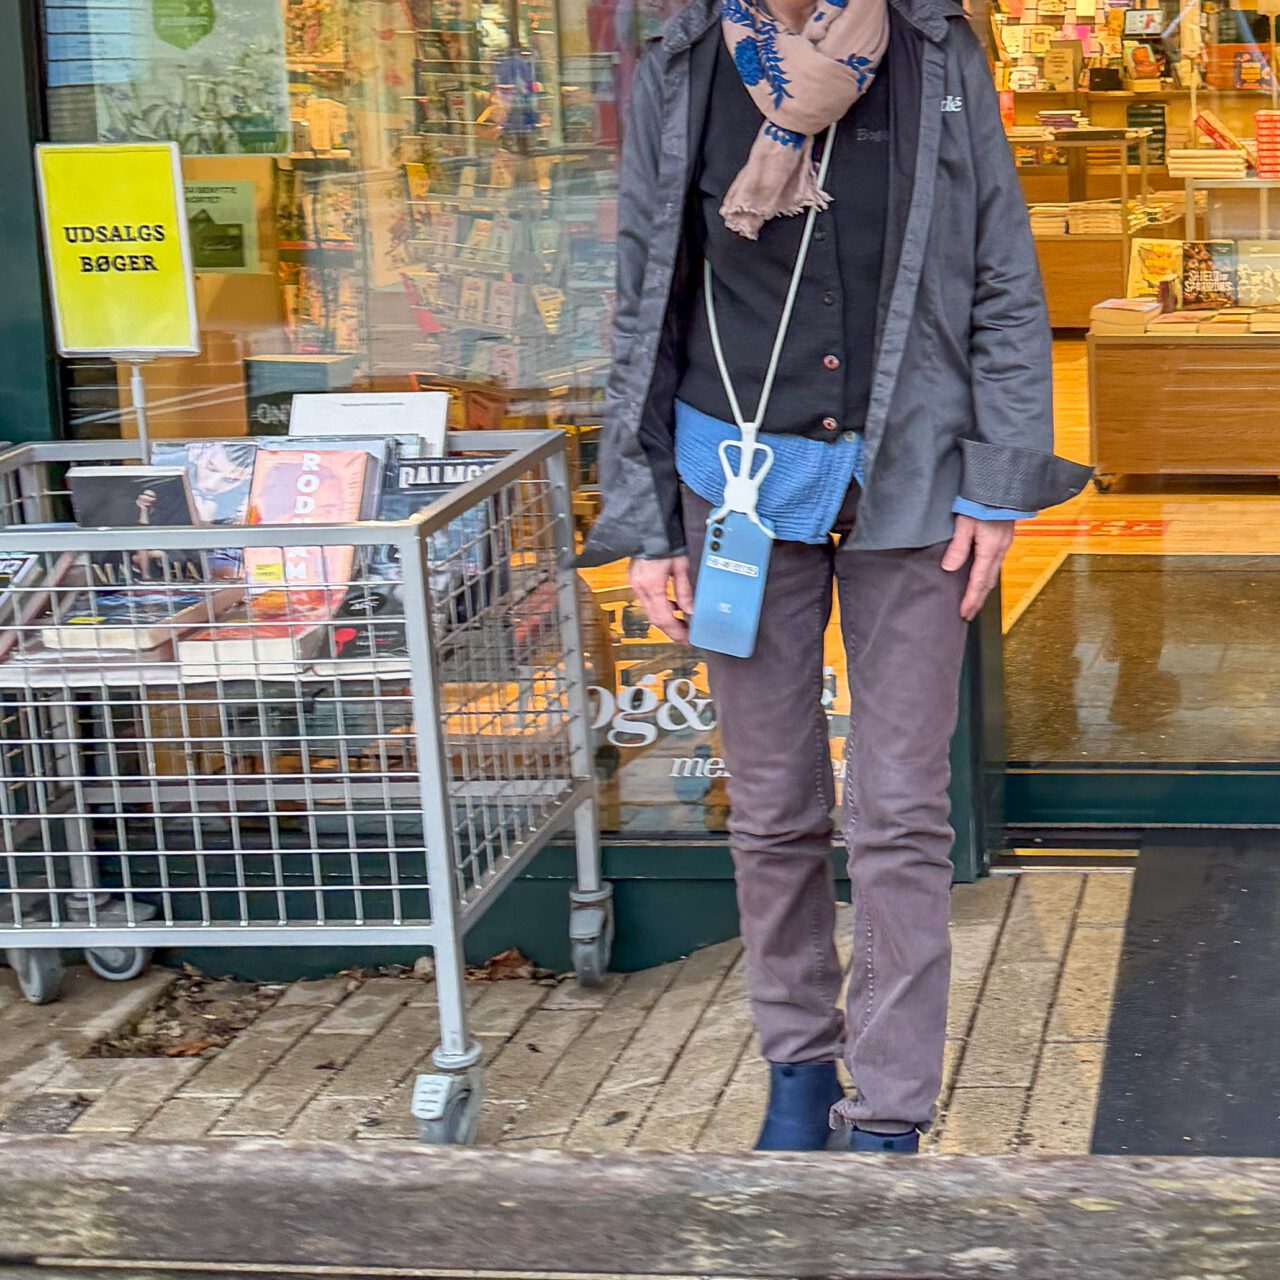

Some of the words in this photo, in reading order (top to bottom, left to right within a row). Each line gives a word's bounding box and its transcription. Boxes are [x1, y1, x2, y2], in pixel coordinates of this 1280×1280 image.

[64, 225, 166, 243] UDSALGS
[79, 255, 159, 272] BØGER
[585, 673, 718, 747] og&
[668, 756, 732, 778] me
